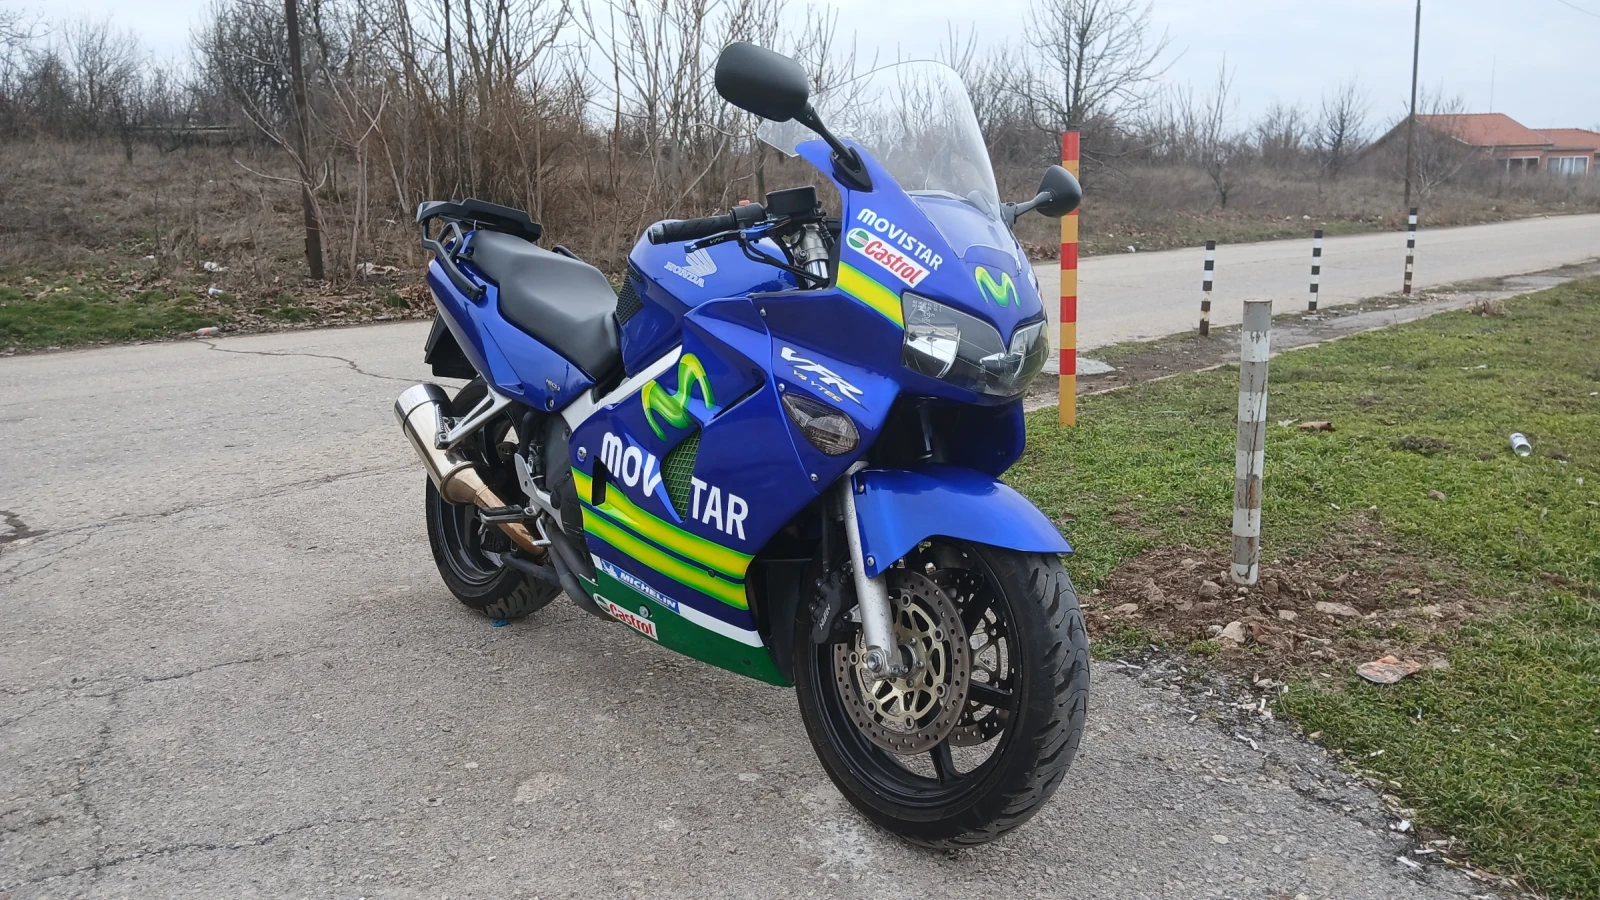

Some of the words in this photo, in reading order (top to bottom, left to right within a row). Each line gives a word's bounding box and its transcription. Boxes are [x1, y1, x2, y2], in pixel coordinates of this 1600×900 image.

[856, 208, 943, 271] MOVISTAR
[663, 261, 705, 288] HONDA
[864, 240, 924, 284] Castrol
[780, 346, 865, 406] VFR
[811, 380, 843, 402] VTEC
[619, 571, 677, 610] MICHELIN
[609, 603, 656, 638] Castrol
